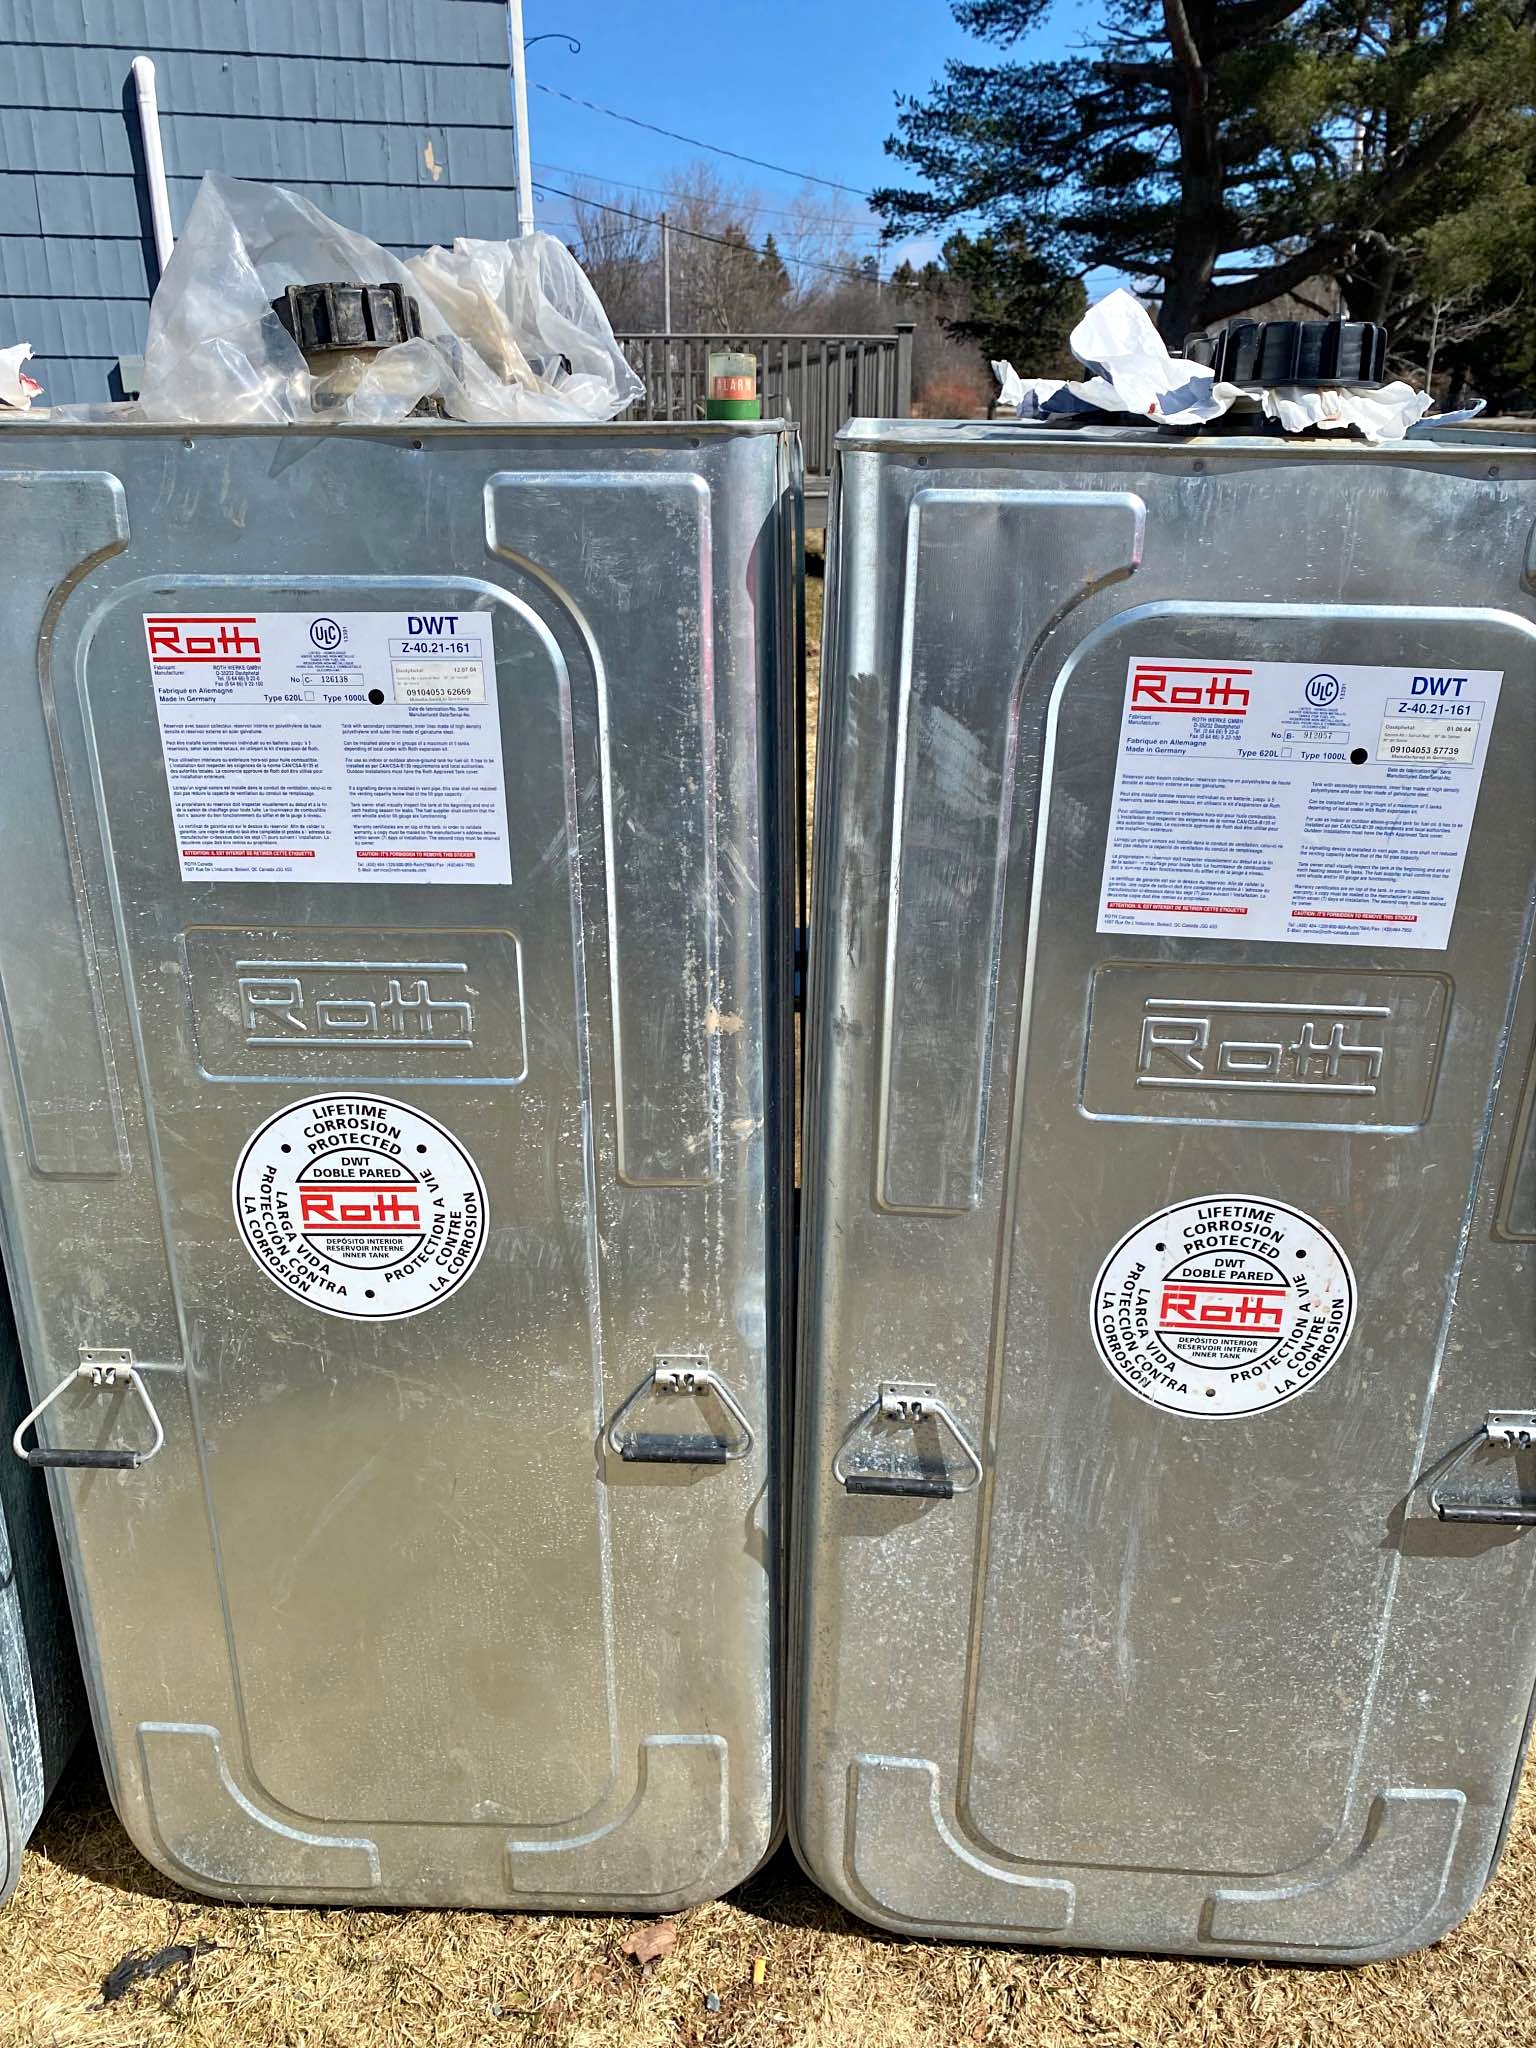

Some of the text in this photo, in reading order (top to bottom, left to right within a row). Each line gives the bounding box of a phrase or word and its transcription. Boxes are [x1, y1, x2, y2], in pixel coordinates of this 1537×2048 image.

[408, 616, 459, 635] DWT
[148, 626, 261, 654] Roth
[401, 642, 470, 653] Z-40.21-161
[199, 688, 234, 696] Allemagne
[1132, 674, 1250, 706] Roth
[1411, 676, 1468, 697] DWT
[186, 696, 217, 704] Germany
[264, 694, 283, 703] Type
[284, 694, 303, 702] 620L
[323, 695, 342, 703] Type
[1398, 702, 1471, 716] Z-40.21-161
[1125, 745, 1145, 753] Made
[1155, 747, 1186, 755] Germany
[1170, 739, 1207, 747] Allemagne
[1390, 745, 1459, 755] 09104053 57739
[1238, 749, 1257, 758] Type
[1259, 749, 1279, 757] 620L
[1301, 752, 1320, 761] Type
[238, 977, 474, 1033] Roth
[1138, 1016, 1384, 1079] Roth
[312, 1104, 387, 1120] LIFETIME
[303, 1118, 401, 1139] CORROSION
[307, 1132, 402, 1155] PROTECTED
[341, 1157, 370, 1167] DWT
[313, 1168, 401, 1178] DOBLE PARED
[299, 1194, 420, 1222] Roth
[1197, 1206, 1275, 1224] LIFETIME
[260, 1165, 348, 1296] PROTECCIÓN CONTRA
[276, 1191, 330, 1276] LARGA VIDA
[384, 1168, 445, 1282] PROTECTION A VIE
[1183, 1220, 1285, 1243] CORROSION
[244, 1196, 311, 1292] LA CORROSIÓN
[326, 1237, 365, 1245] DEPÓSITO
[429, 1191, 478, 1292] LA CORROSION
[435, 1210, 462, 1266] CONTRE
[1183, 1235, 1280, 1260] PROTECTED
[1214, 1258, 1245, 1269] DWT
[1182, 1268, 1273, 1282] DOBLE PARED
[1159, 1292, 1283, 1325] Roth
[1118, 1262, 1188, 1395] PROTECCIÓN CONTRA
[1135, 1288, 1176, 1373] LARGA VIDA
[1230, 1273, 1312, 1383] PROTECTION A VIE
[1102, 1291, 1152, 1390] LA CORROSIÓN
[1177, 1344, 1258, 1354] RESERVOIR INTERNE
[1178, 1336, 1258, 1347] DEPÓSITO INTERIOR
[1274, 1298, 1345, 1395] LA CORROSION
[1287, 1315, 1327, 1370] CONTRE
[1218, 1352, 1241, 1360] TANK
